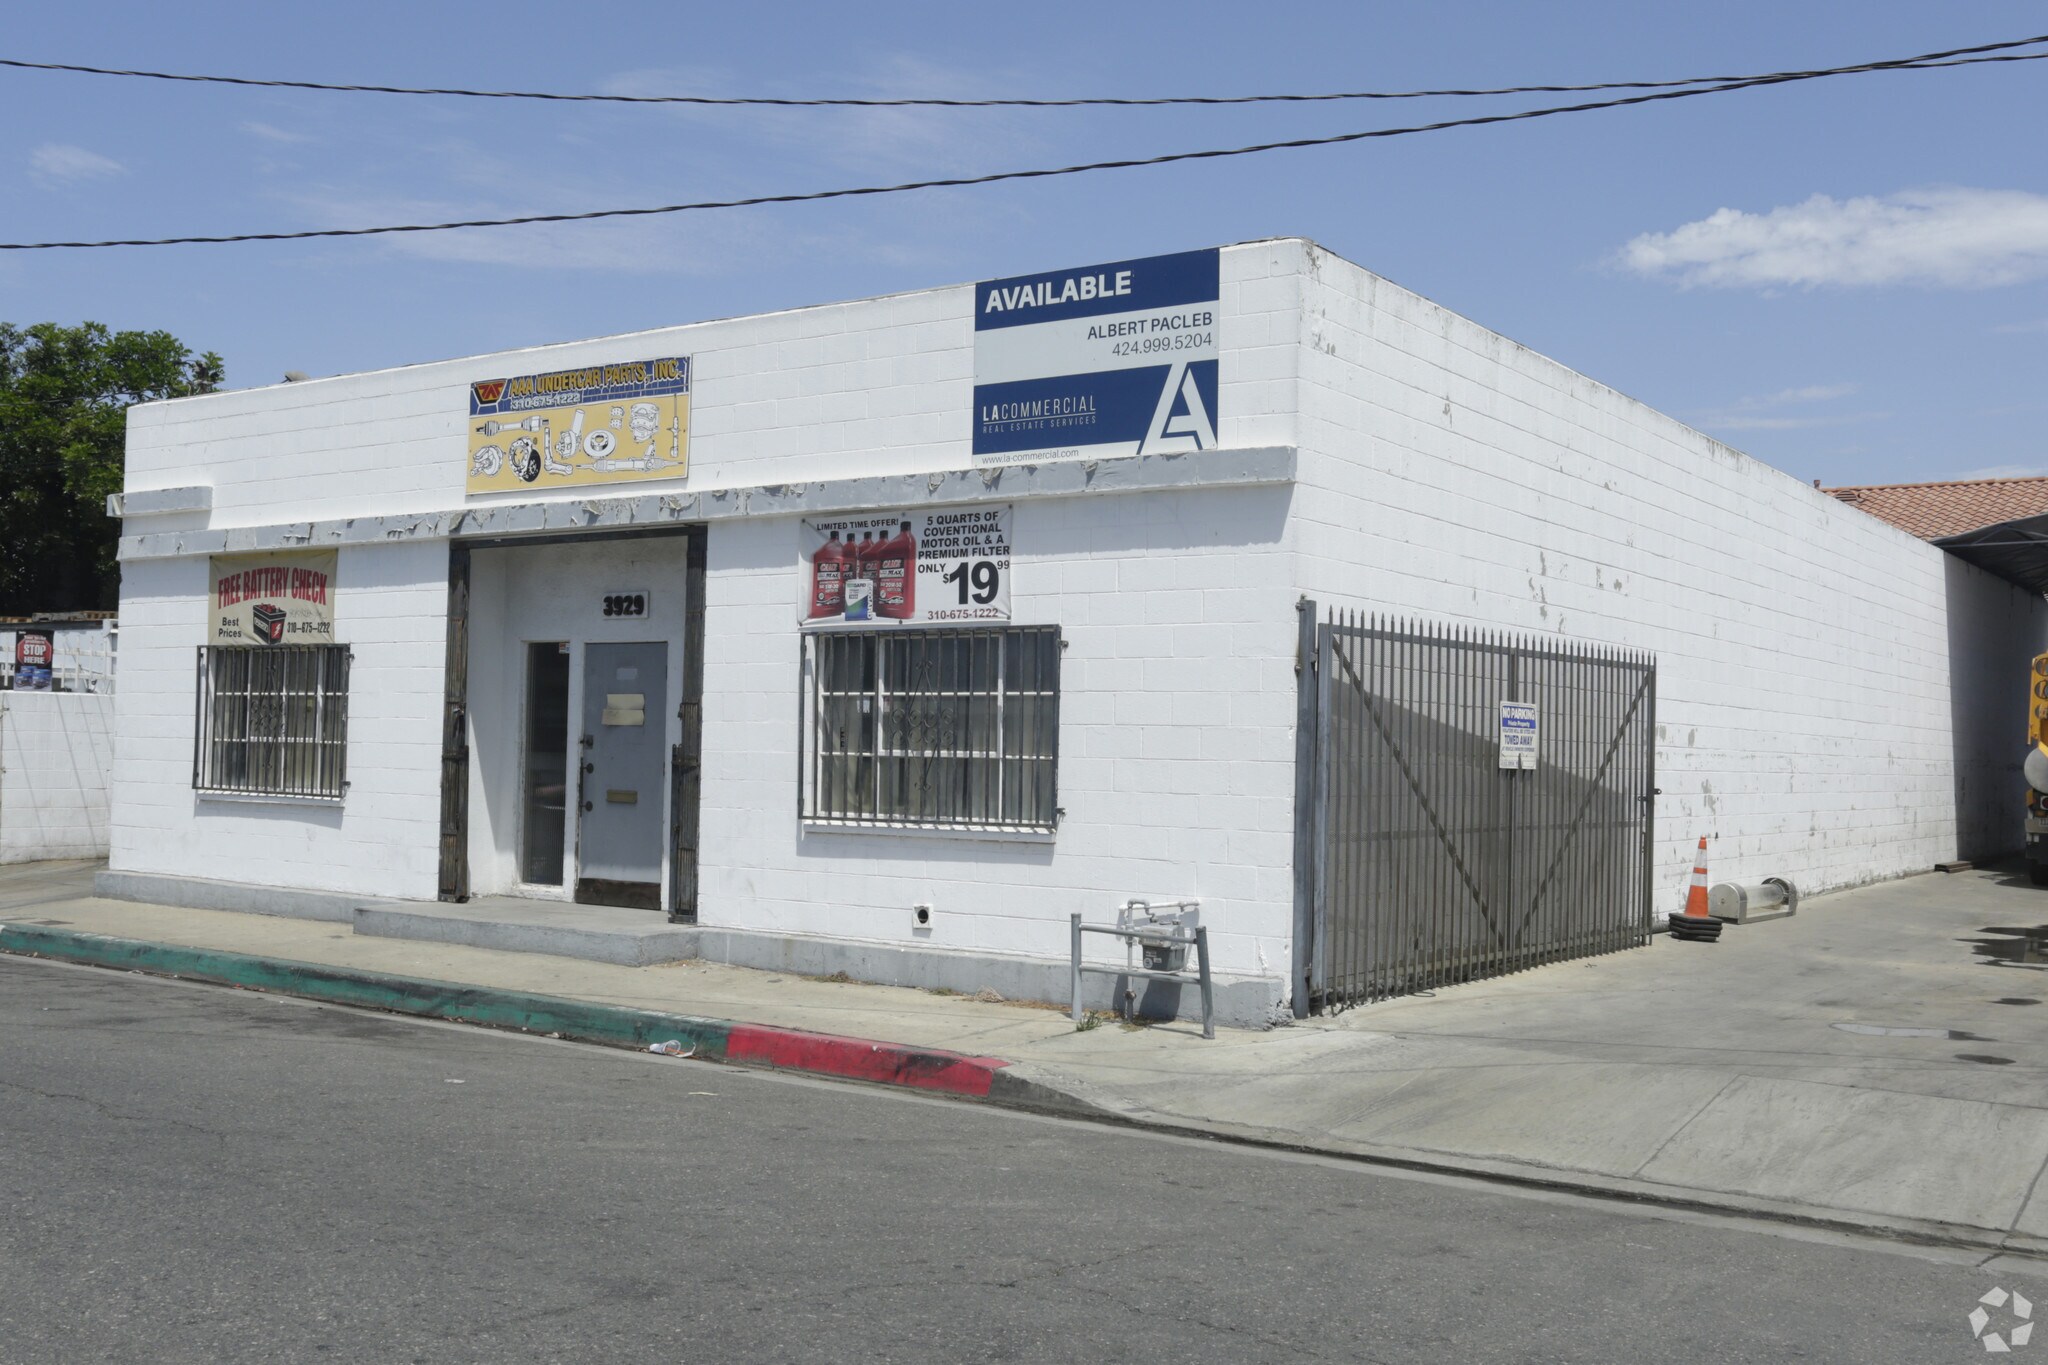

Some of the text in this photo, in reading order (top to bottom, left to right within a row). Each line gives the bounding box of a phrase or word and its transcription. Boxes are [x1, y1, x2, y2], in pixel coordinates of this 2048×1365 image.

[985, 270, 1132, 313] AVAILABLE
[1087, 312, 1212, 340] ALBERT PACLEB
[1112, 332, 1212, 357] 424.999.5204
[509, 375, 533, 398] AAA
[536, 369, 600, 394] UNDERCAR
[653, 359, 683, 381] INC.
[983, 395, 1096, 422] LACOMMERCIAL
[983, 416, 1096, 434] REAL ESTATE SERVICES
[981, 448, 1079, 465] www.la-commercial.com
[817, 518, 899, 530] LIMITED TIME OFFER!
[927, 512, 999, 526] 5 QUARTS OF
[924, 522, 1001, 537] COVENTIONAL
[921, 534, 1004, 548] MOTOR OIL & A
[918, 546, 1010, 560] PREMIUM FILTER
[918, 563, 946, 574] ONLY
[218, 566, 328, 610] FREE BATTERY CHECK
[603, 594, 644, 616] 3929
[928, 608, 999, 620] 310-675-1222
[222, 617, 239, 626] Best
[218, 628, 242, 638] Prices
[24, 644, 46, 656] STOP
[24, 656, 46, 664] HERE
[1502, 706, 1535, 720] NO PARKING
[1504, 734, 1534, 746] TOWED AWAY
